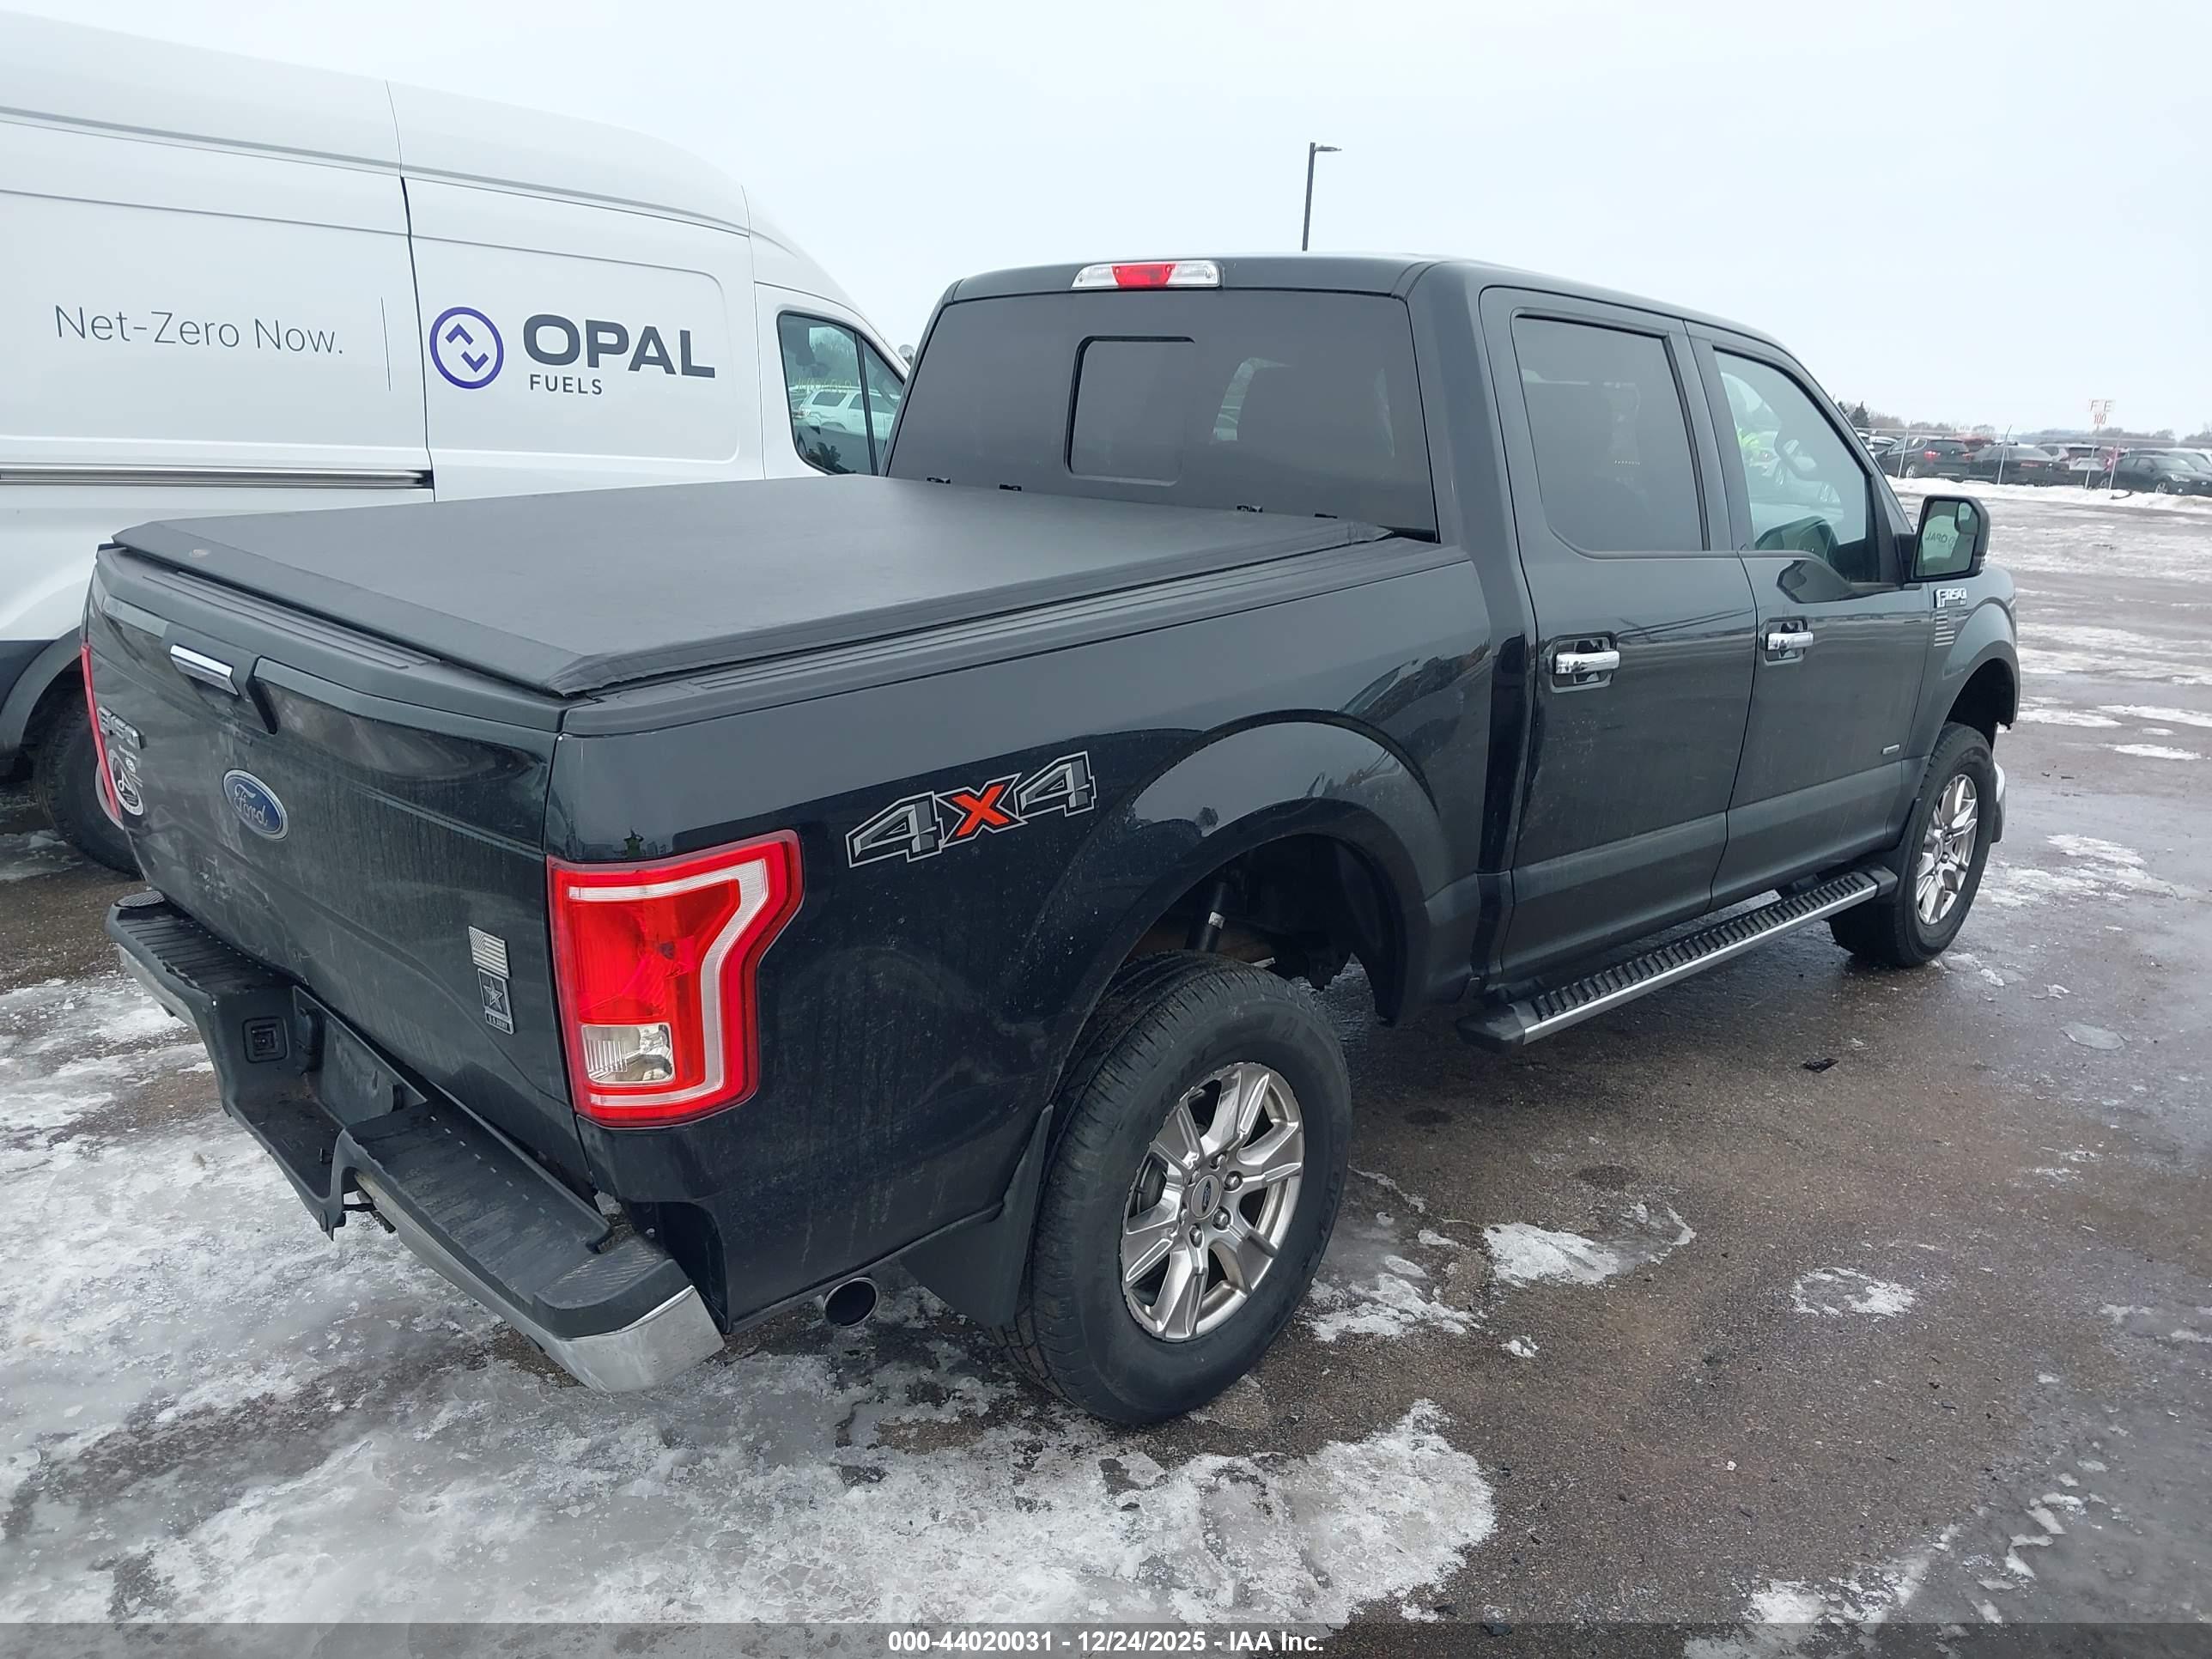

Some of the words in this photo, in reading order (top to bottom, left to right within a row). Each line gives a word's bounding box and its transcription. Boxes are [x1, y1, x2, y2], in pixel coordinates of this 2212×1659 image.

[54, 304, 241, 349] Net-Zero
[253, 318, 344, 356] Now.
[522, 313, 716, 380] OPAL
[529, 373, 604, 397] FUELS
[233, 782, 270, 828] Ford
